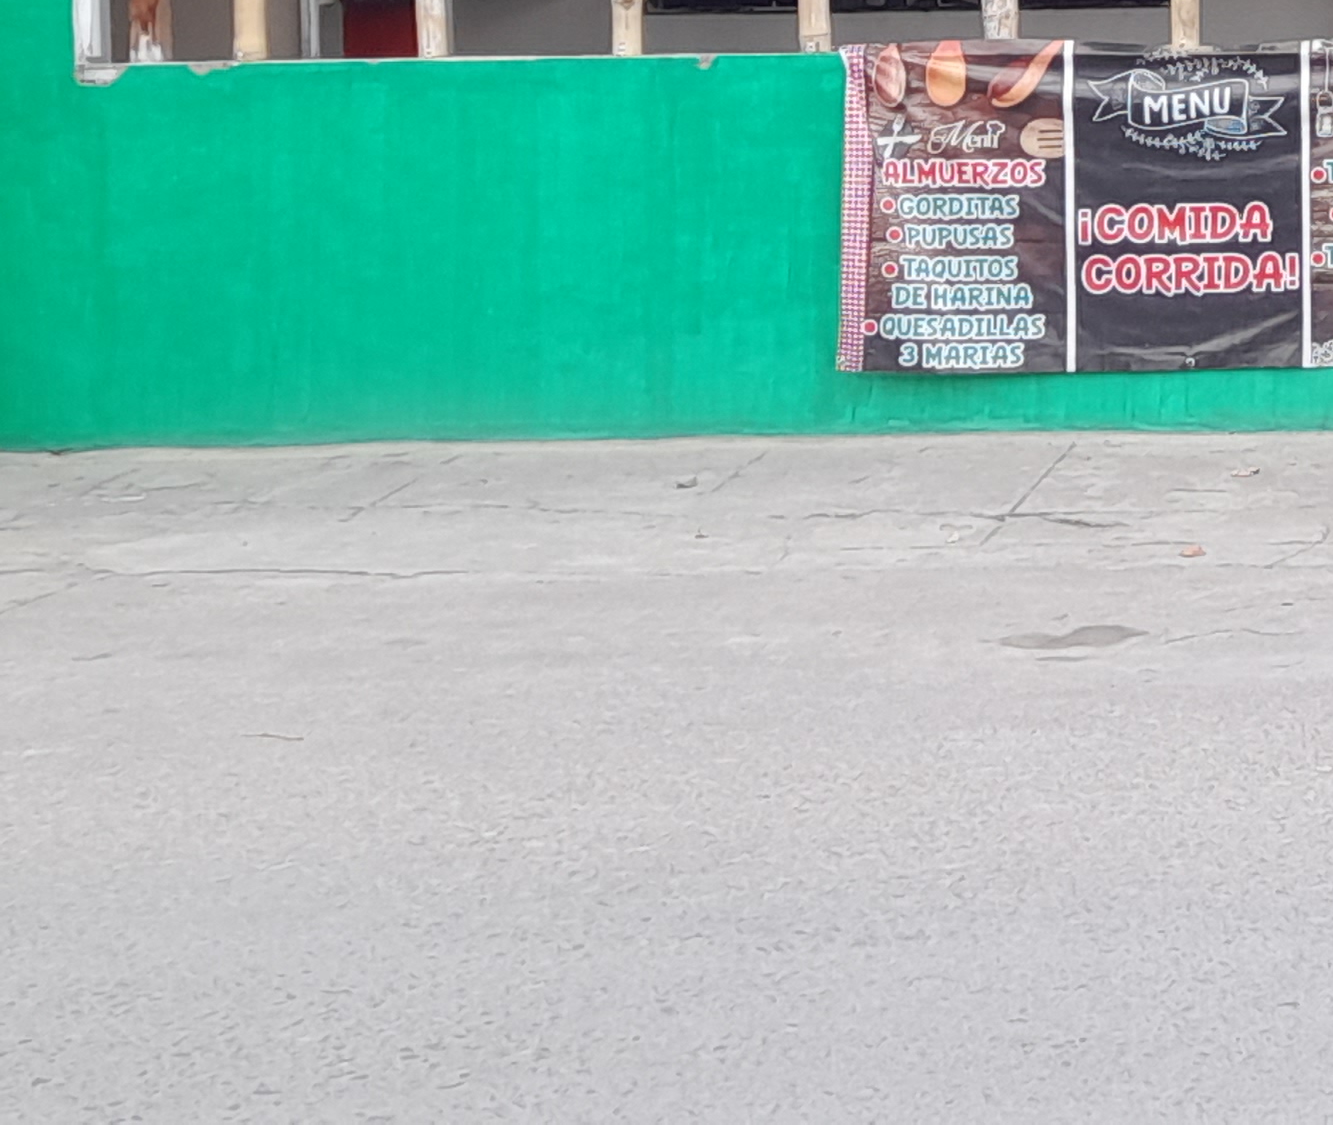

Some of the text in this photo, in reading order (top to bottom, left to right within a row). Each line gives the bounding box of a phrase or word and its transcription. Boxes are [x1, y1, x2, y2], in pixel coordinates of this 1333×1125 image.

[1142, 87, 1231, 125] MENU
[882, 158, 1046, 188] ALMUERZOS
[899, 194, 1020, 219] GORDITAS
[905, 224, 1014, 248] PUPUSAS
[1078, 201, 1273, 245] ¡COMIDA
[901, 255, 1018, 281] TAQUITOS
[1082, 251, 1299, 296] CORRIDA!
[892, 283, 1034, 310] DE HARINA
[880, 314, 1046, 340] QUESADILLAS
[899, 342, 1024, 369] 3 MARIAS
